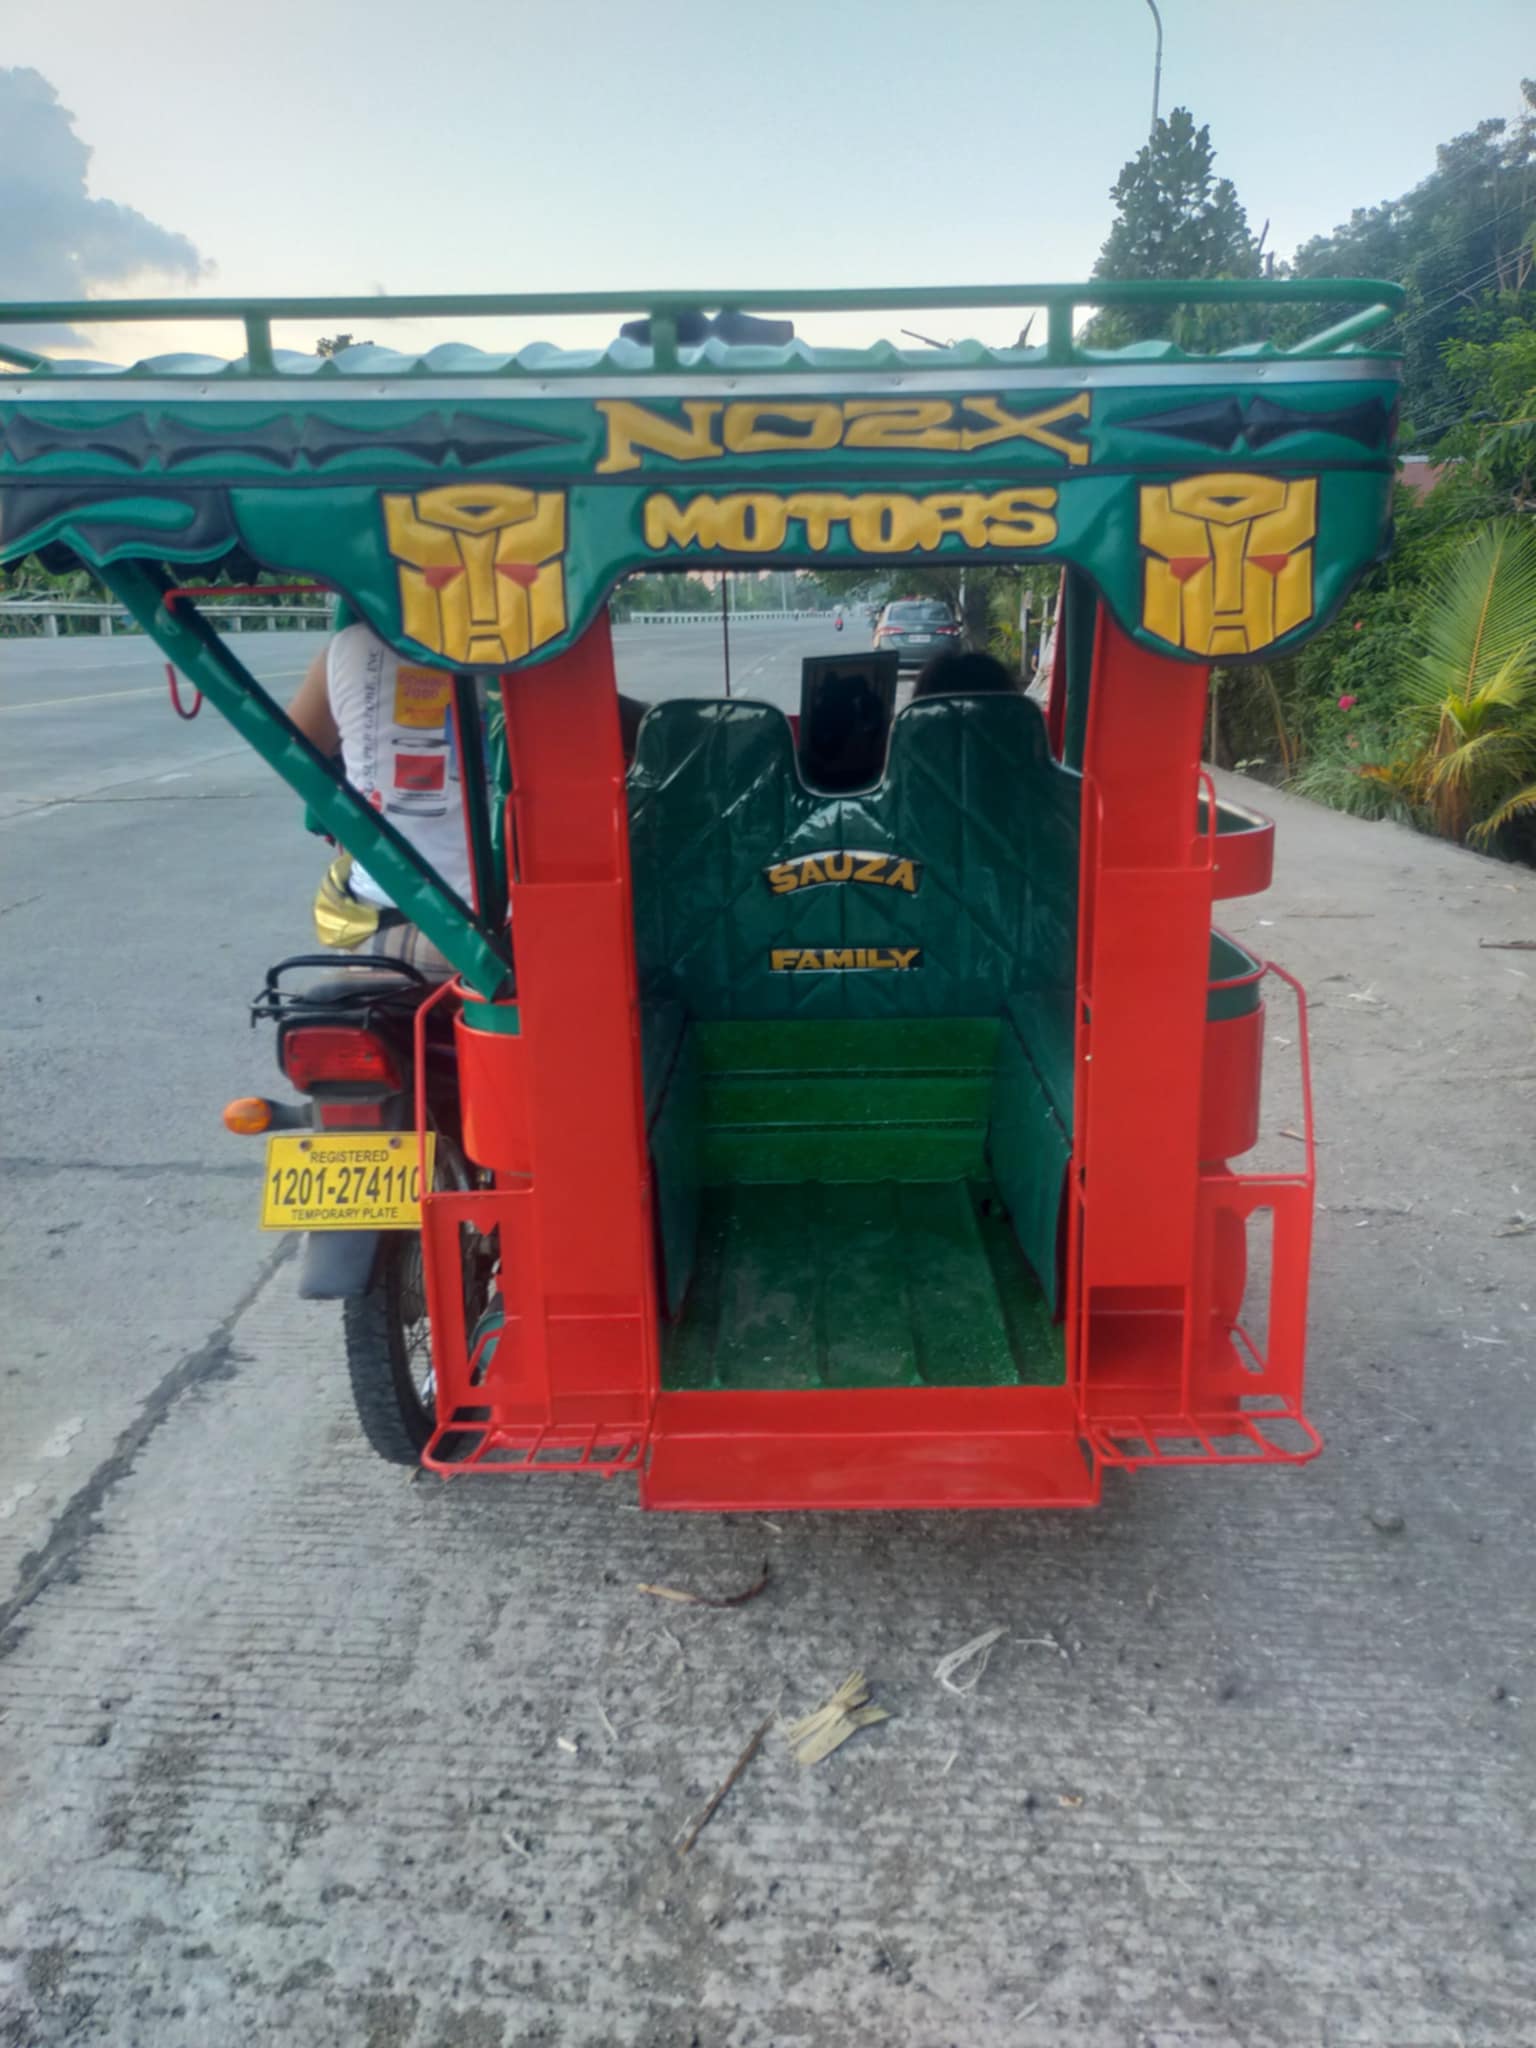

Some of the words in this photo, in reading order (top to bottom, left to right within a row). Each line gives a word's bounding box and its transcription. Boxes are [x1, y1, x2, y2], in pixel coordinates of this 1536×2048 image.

[643, 487, 1059, 553] MOTORS
[768, 853, 917, 894] SAUZA
[770, 949, 921, 970] FAMILY
[309, 1150, 389, 1164] REGISTERED
[291, 1209, 359, 1221] TEMPORARY
[362, 1207, 399, 1219] PLATE
